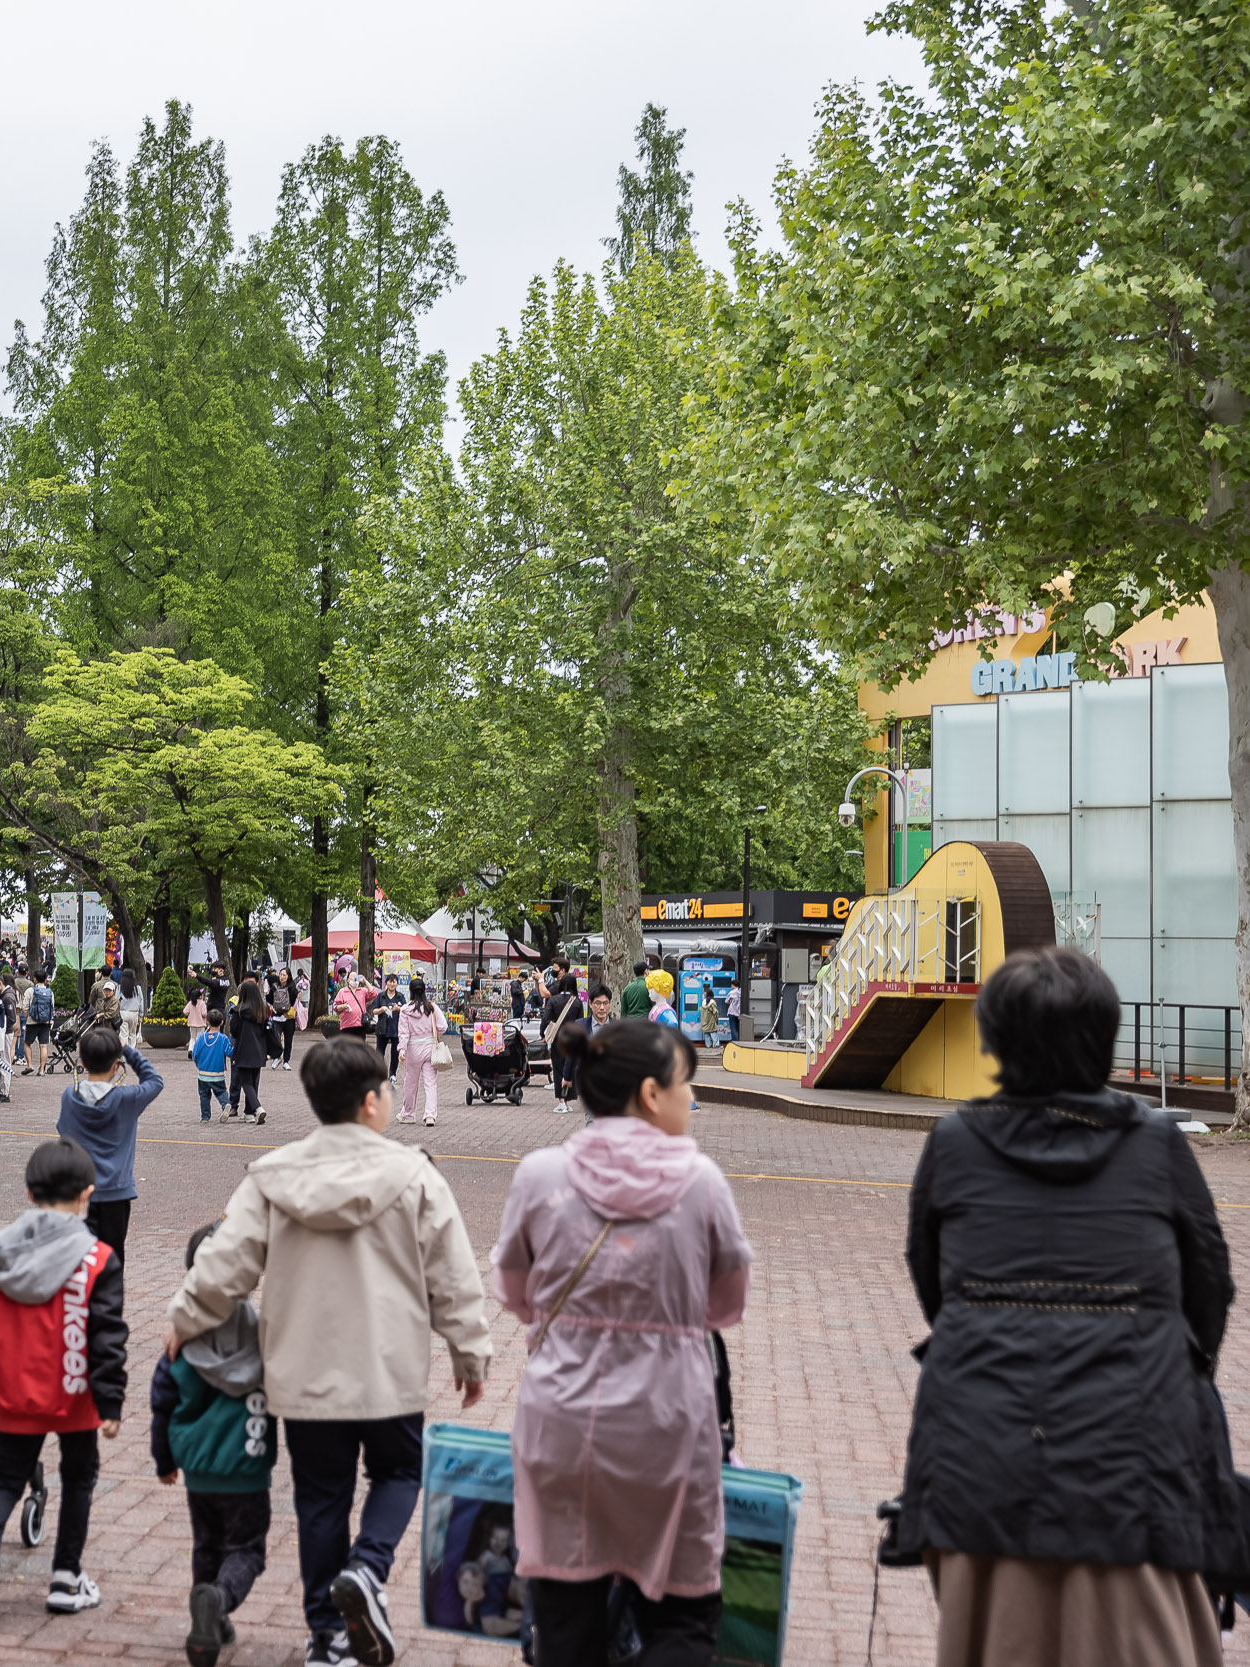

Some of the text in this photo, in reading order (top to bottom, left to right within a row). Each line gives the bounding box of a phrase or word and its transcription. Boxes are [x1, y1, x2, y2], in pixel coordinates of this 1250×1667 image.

[970, 636, 1188, 696] GRAND ARK
[658, 898, 703, 920] emart24
